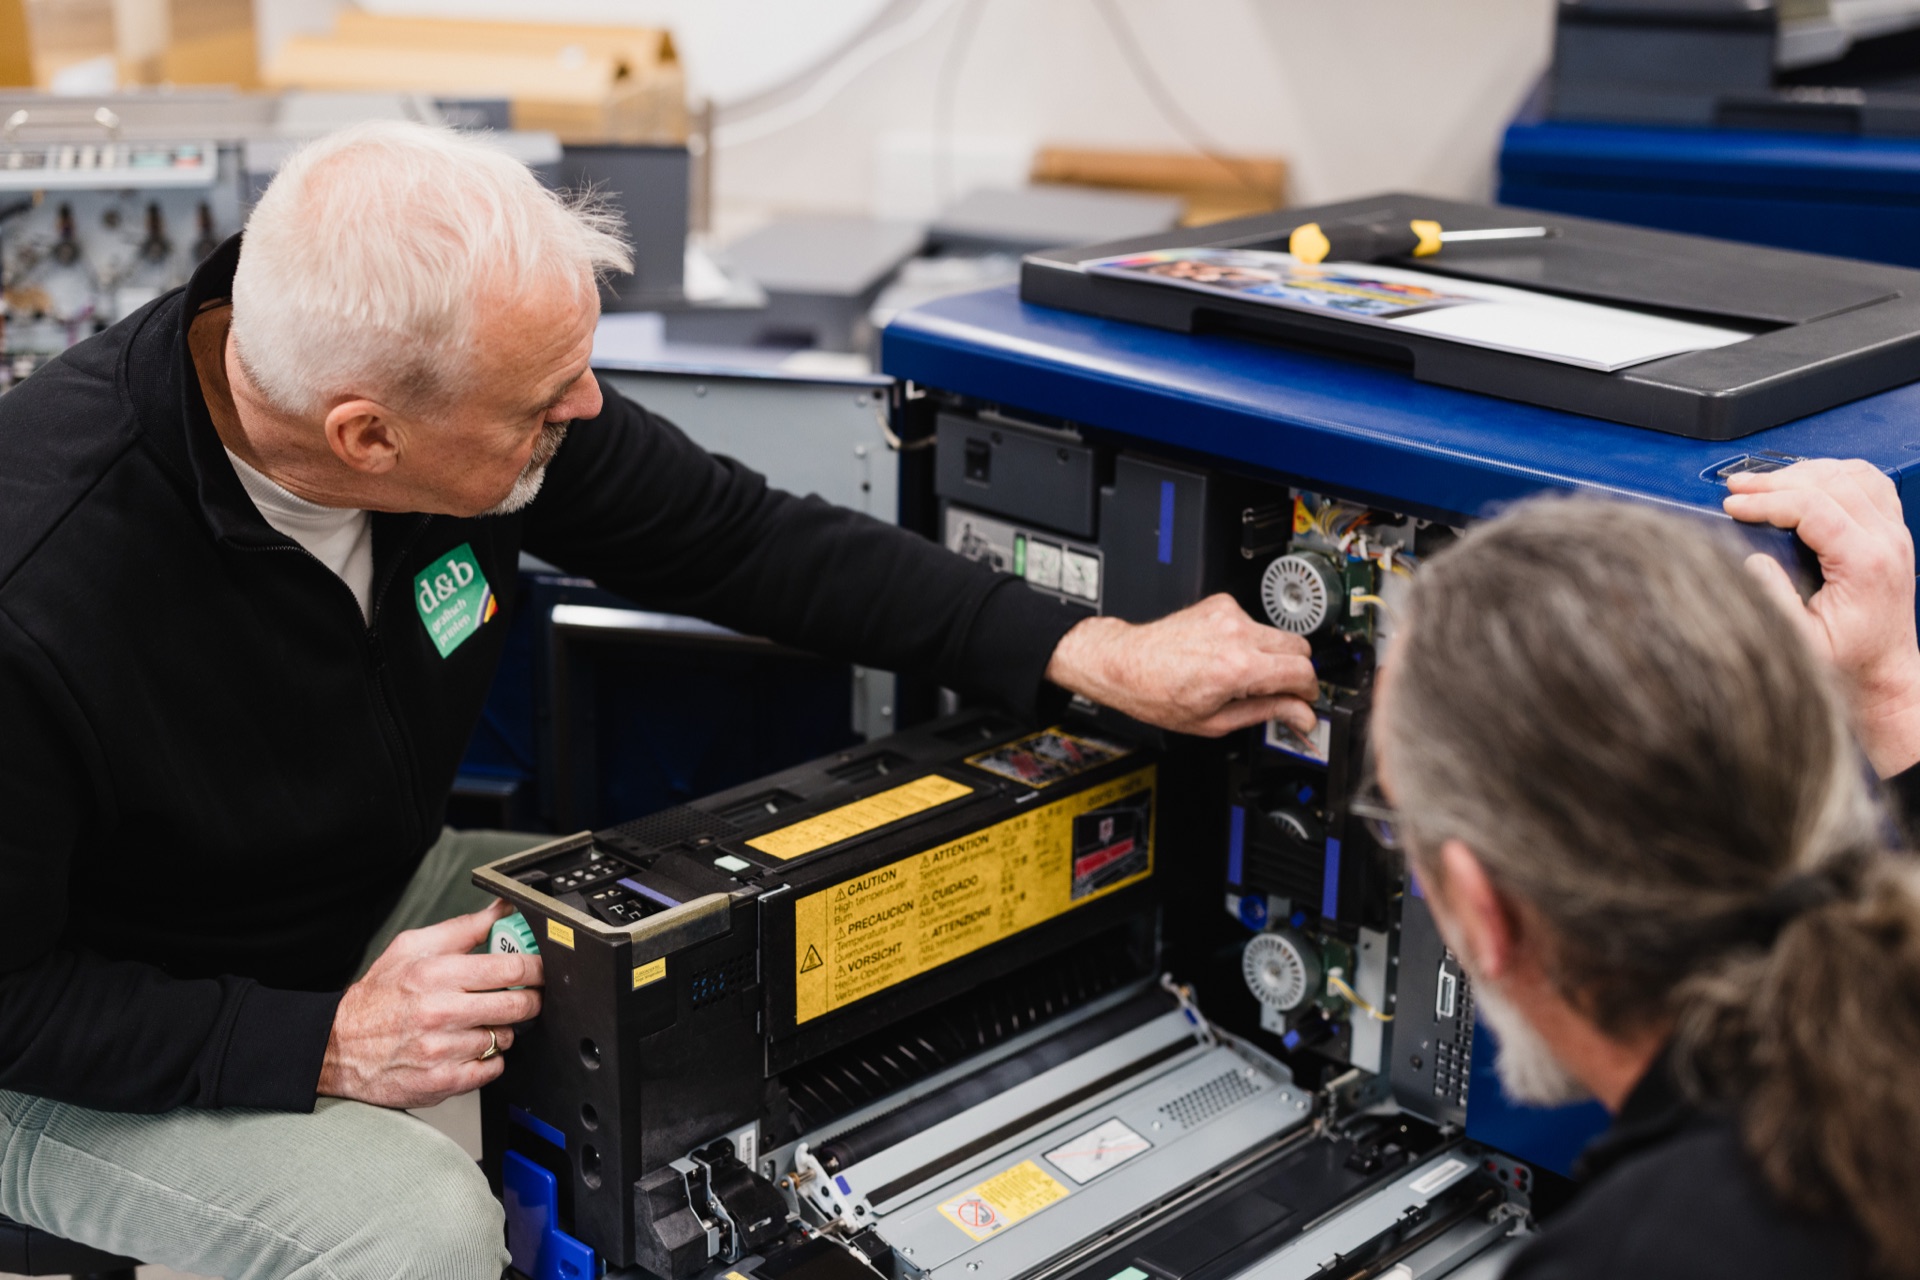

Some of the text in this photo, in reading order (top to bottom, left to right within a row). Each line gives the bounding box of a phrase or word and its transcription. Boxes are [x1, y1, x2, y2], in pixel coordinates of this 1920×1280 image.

[419, 559, 474, 614] d&b
[932, 834, 990, 863] ATTENTION
[847, 868, 897, 896] CAUTION
[932, 874, 979, 901] CUIDADO
[834, 900, 854, 915] High
[834, 912, 853, 926] Burn
[848, 900, 915, 935] PRECAUCION
[931, 904, 992, 938] ATTENZIONE
[848, 942, 903, 972] VORSICHT
